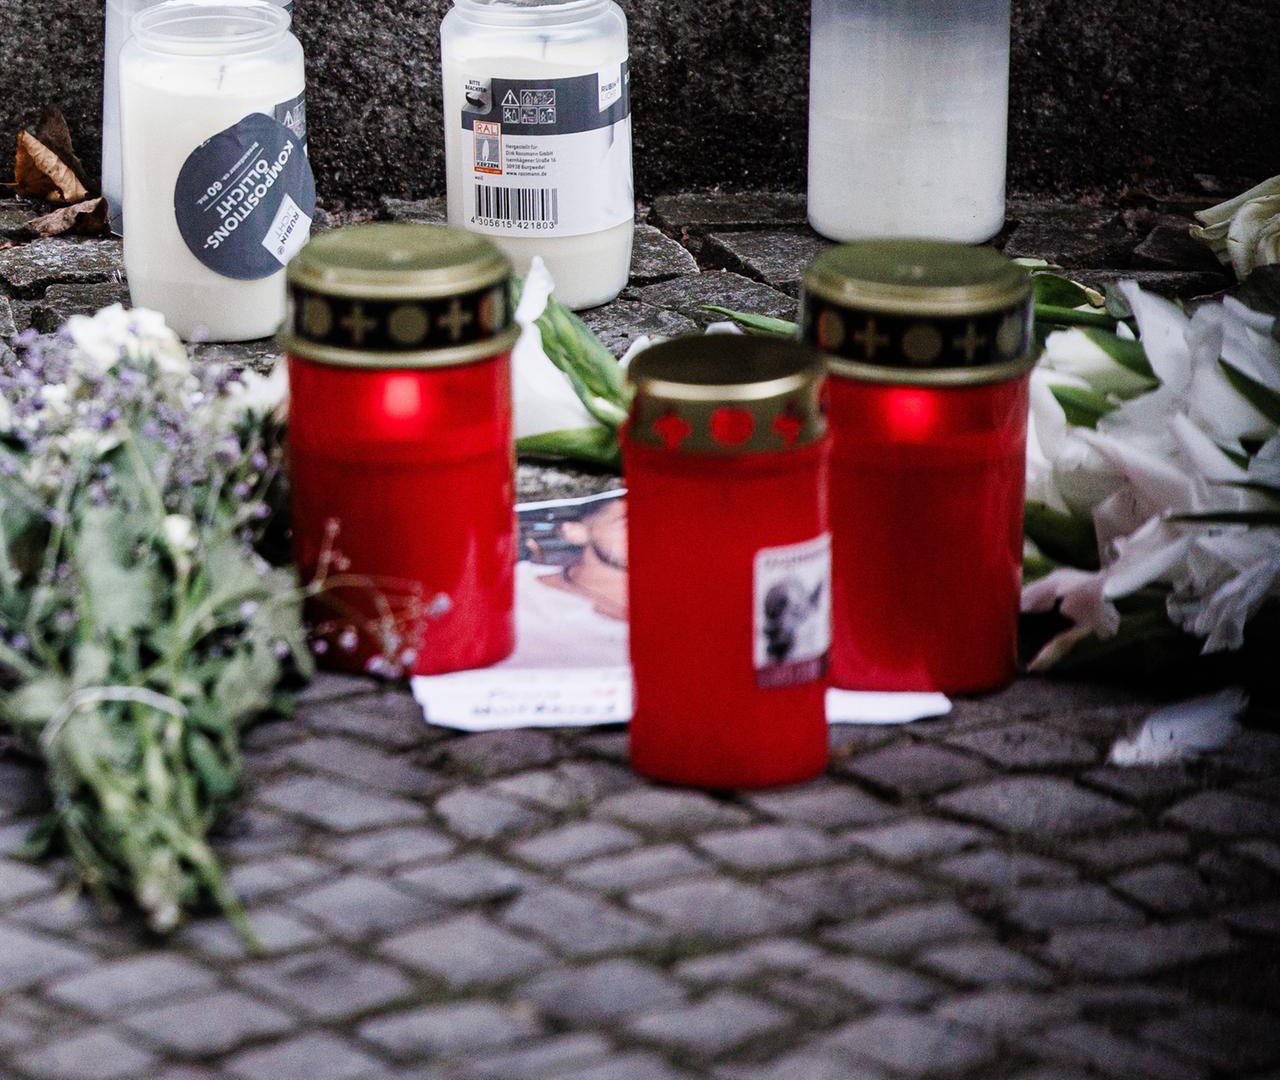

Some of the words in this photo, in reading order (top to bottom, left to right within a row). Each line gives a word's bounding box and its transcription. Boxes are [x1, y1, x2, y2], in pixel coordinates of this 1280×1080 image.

[477, 123, 497, 135] RAL
[203, 139, 295, 249] KOMPOSITIONS-
[207, 181, 223, 197] 60
[215, 159, 270, 219] ÖLLICHT
[280, 212, 300, 245] RUBIN
[471, 216, 476, 224] 4
[478, 219, 513, 228] 305615
[517, 221, 555, 230] 421803
